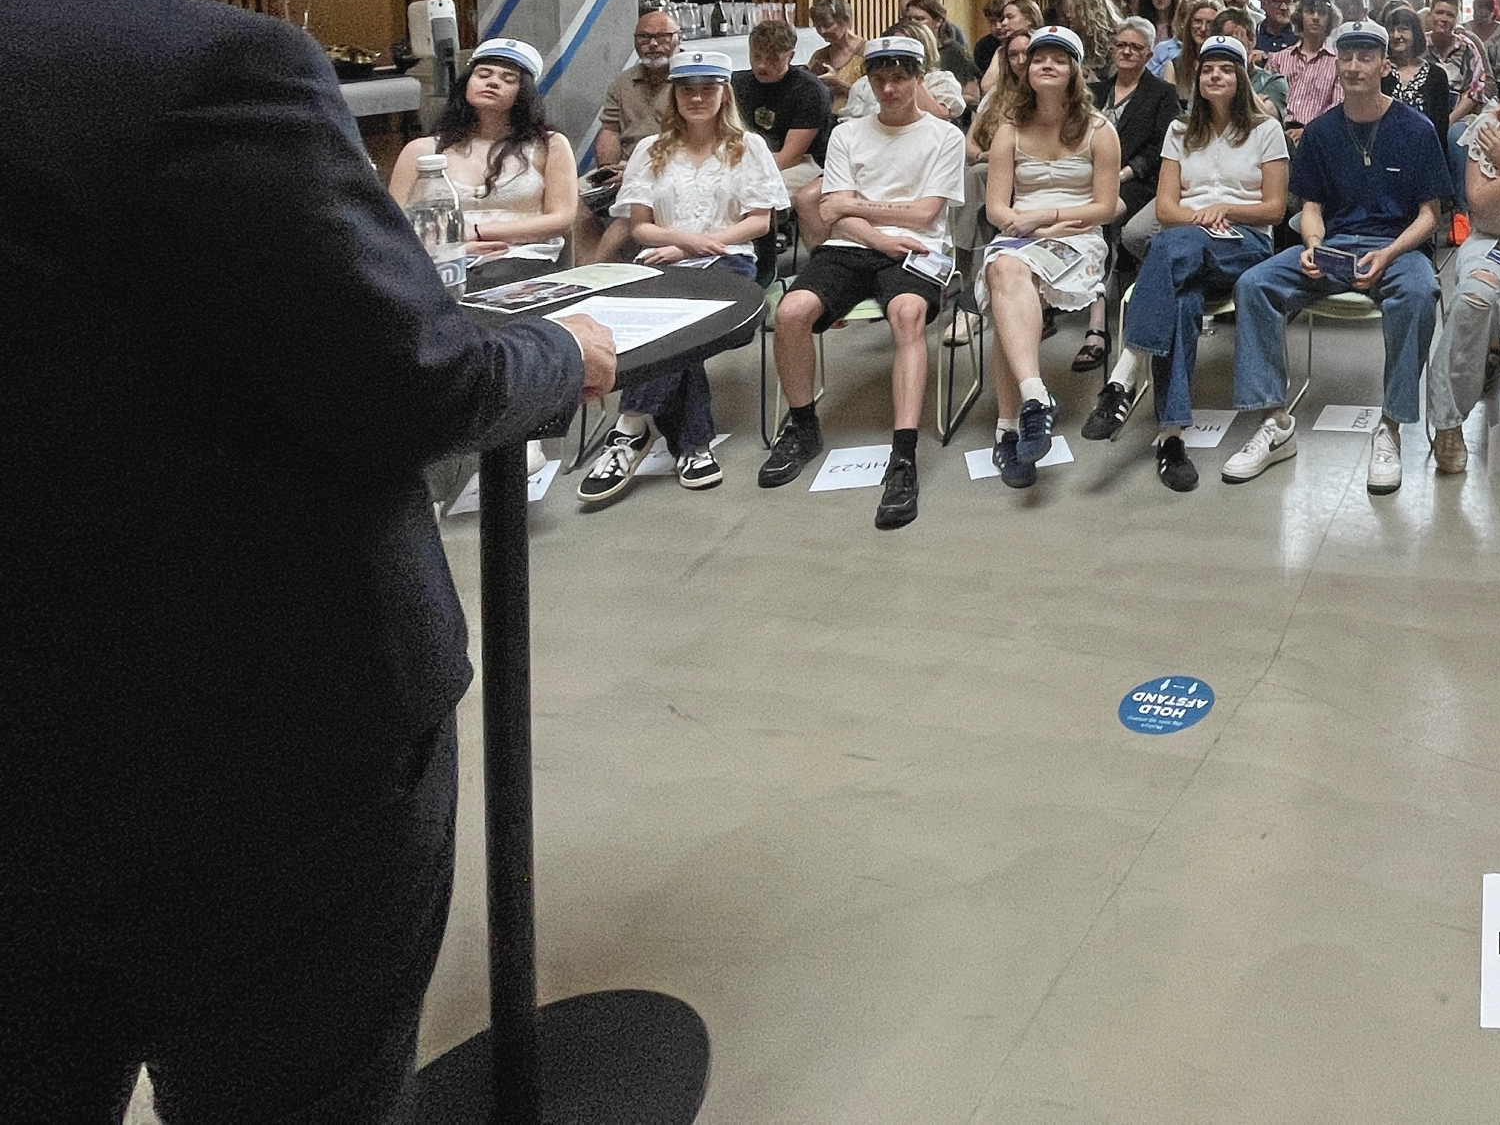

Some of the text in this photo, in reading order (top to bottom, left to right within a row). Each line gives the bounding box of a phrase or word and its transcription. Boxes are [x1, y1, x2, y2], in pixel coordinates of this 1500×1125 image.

[829, 460, 888, 474] Hfx22
[1132, 691, 1209, 709] AFSTAND
[1138, 704, 1187, 719] HOLD
